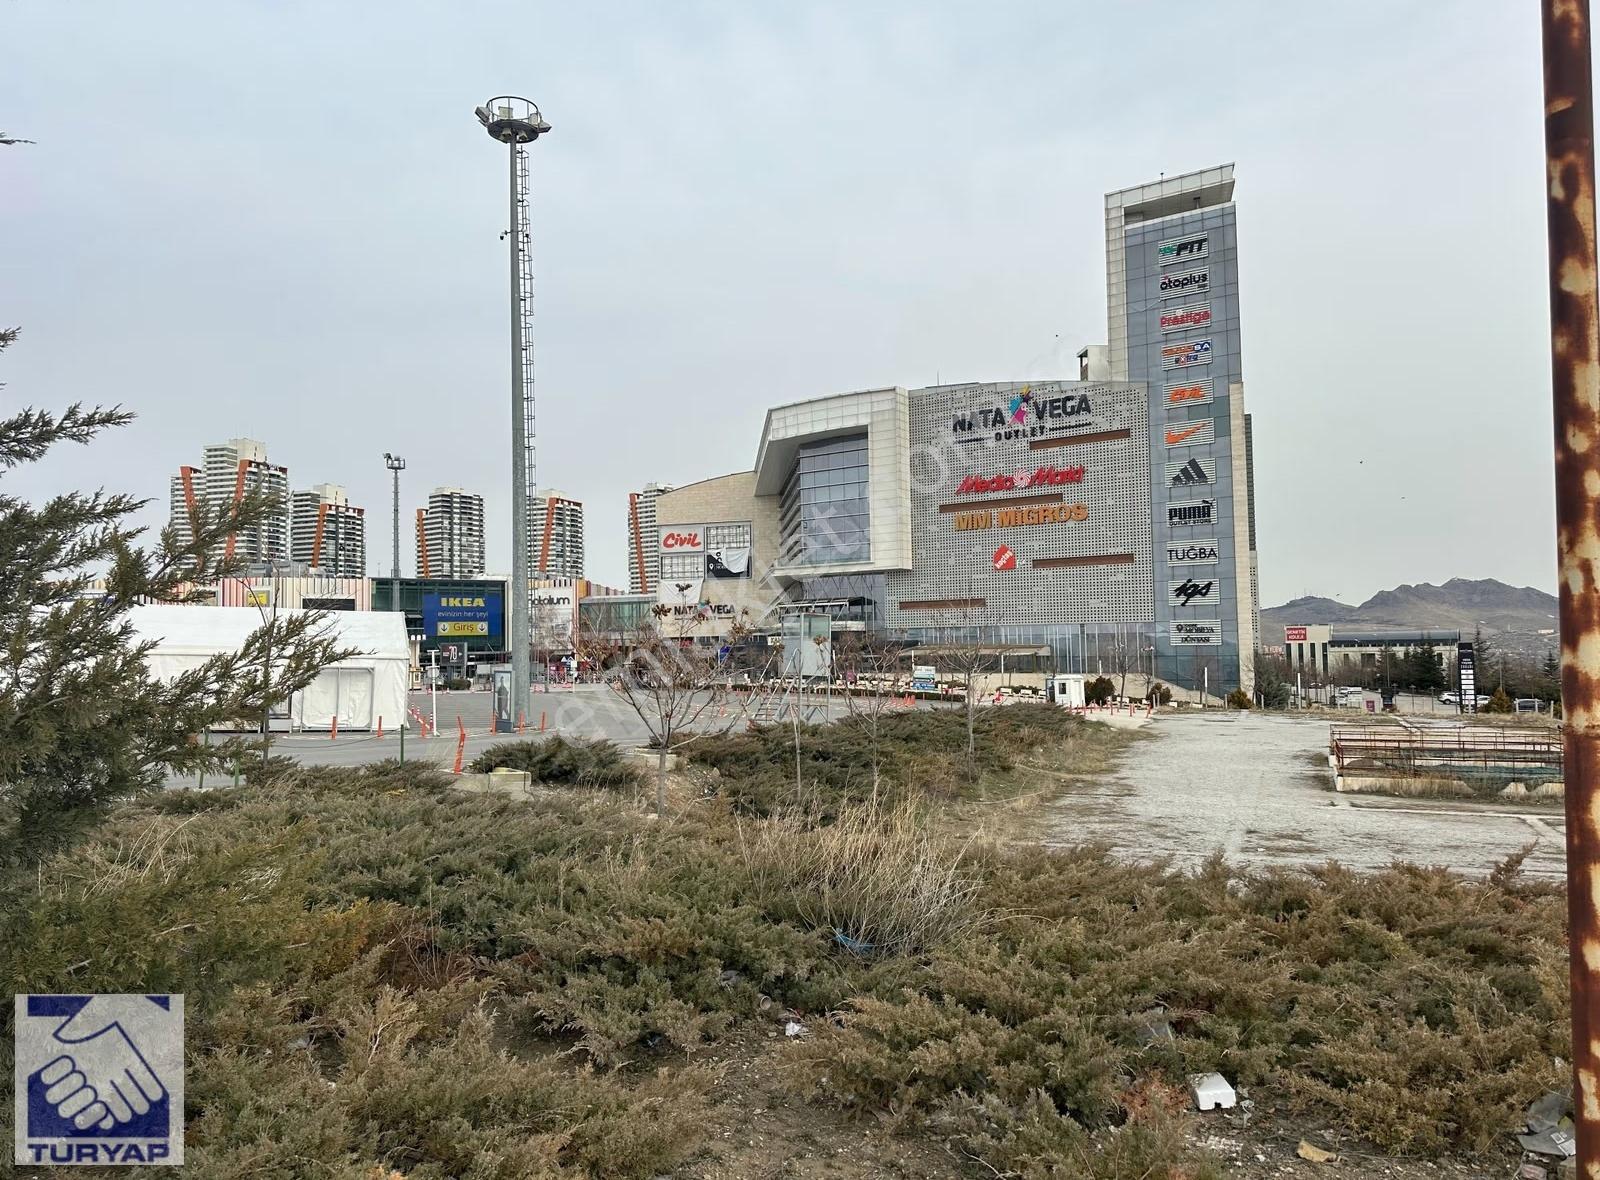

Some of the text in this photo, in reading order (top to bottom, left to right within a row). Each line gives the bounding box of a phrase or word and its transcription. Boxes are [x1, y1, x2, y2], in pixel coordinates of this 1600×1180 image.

[1160, 273, 1208, 290] otoplus
[952, 393, 1092, 432] NATA VEGA
[994, 425, 1046, 441] OUTLET
[1168, 505, 1211, 520] PUMA
[954, 512, 992, 531] MM
[1167, 545, 1218, 561] TUĞBA
[441, 597, 484, 607] IKEA
[710, 604, 736, 614] VEGA
[453, 622, 474, 632] Giriş
